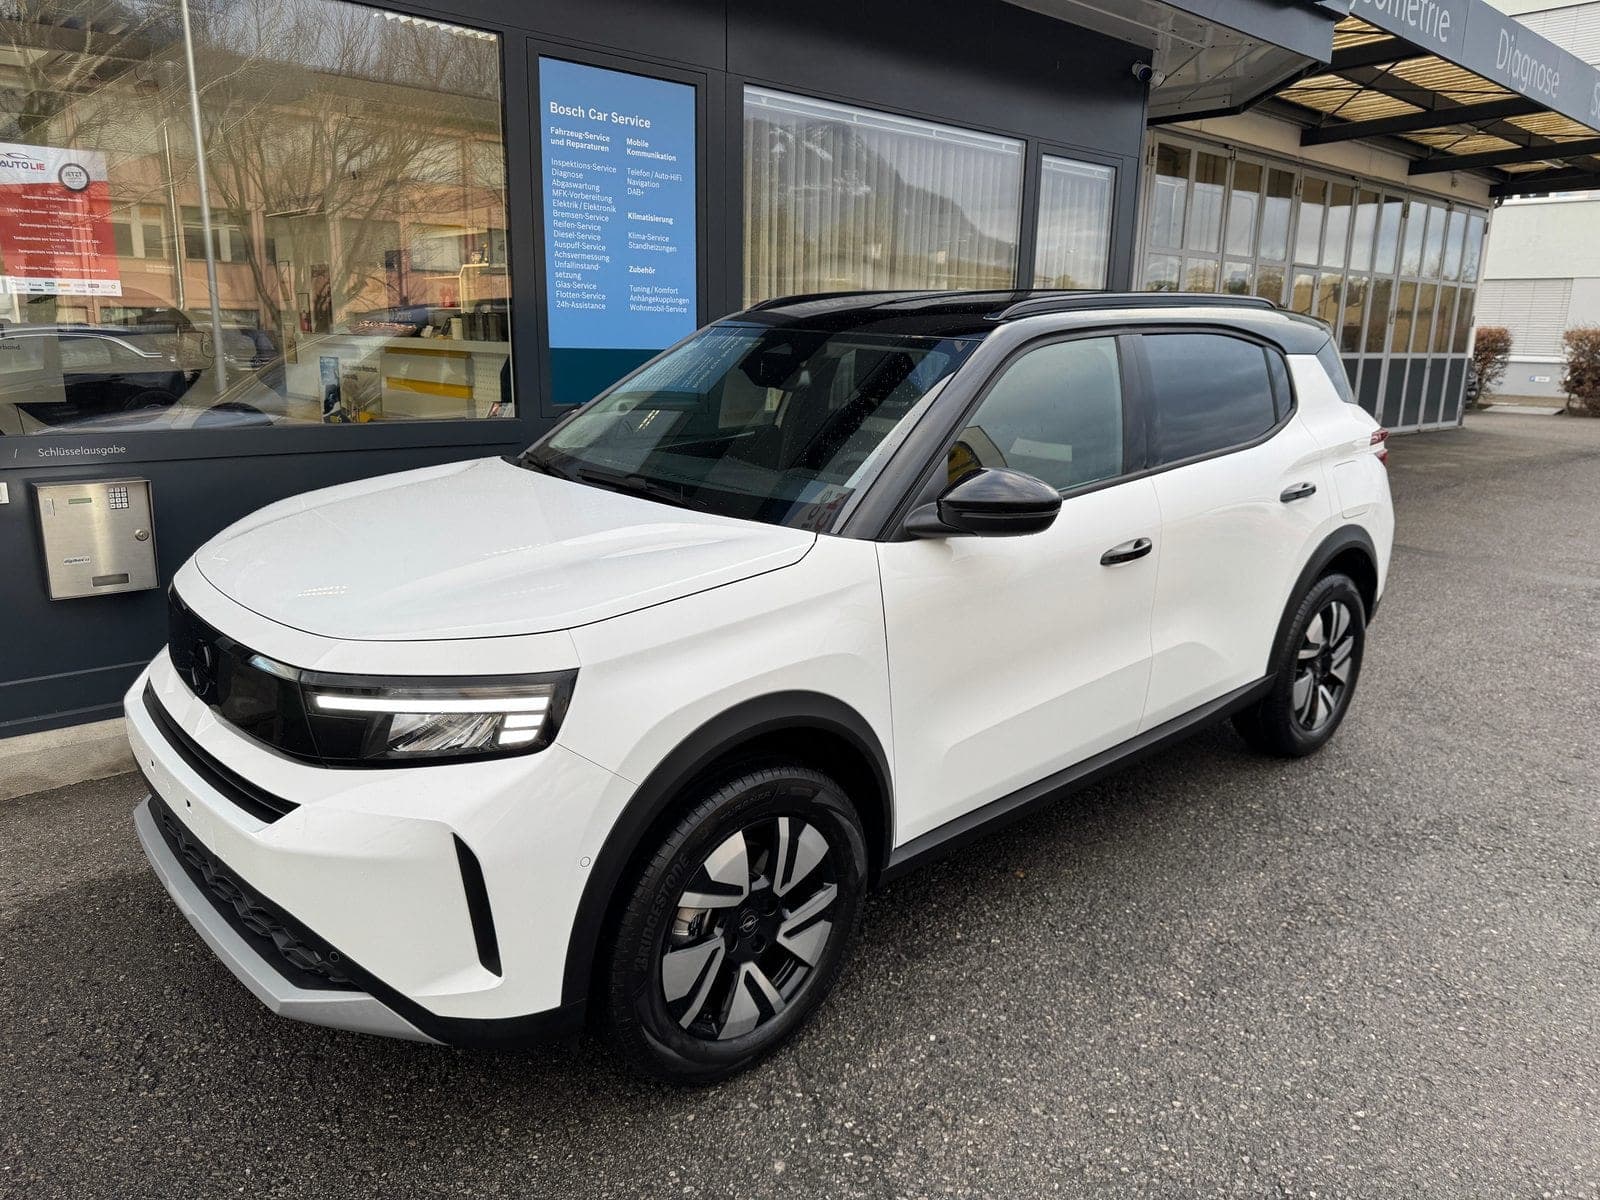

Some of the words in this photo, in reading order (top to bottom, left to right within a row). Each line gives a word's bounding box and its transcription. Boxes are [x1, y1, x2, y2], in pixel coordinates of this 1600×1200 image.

[1496, 28, 1560, 98] Diagnose
[549, 101, 585, 118] Bosch
[588, 108, 609, 122] Car
[611, 112, 651, 128] Service
[550, 126, 610, 143] Fahrzeug-Service
[550, 138, 565, 146] und
[566, 139, 609, 152] Reparaturen
[626, 137, 649, 148] Mobile
[626, 148, 677, 161] Kommunikation
[551, 158, 617, 173] Inspektions-Service
[551, 169, 584, 180] Diagnose
[627, 167, 650, 177] Telefon
[551, 179, 600, 192] Abgaswartung
[627, 178, 660, 188] Navigation
[552, 189, 613, 203] MFK-Vorbereitung
[552, 200, 578, 209] Elektrik
[583, 203, 616, 212] Elektronik
[552, 210, 609, 222] Bremsen-Service
[627, 212, 674, 225] Klimatisierung
[553, 220, 601, 231] Reifen-Service
[553, 230, 601, 241] Diesel-Service
[627, 232, 669, 242] Klima-Service
[554, 240, 606, 251] Auspuff-Service
[628, 242, 677, 253] Standheizungen
[554, 251, 610, 262] Achsvermessung
[554, 261, 601, 271] Unfallinstand-
[628, 265, 656, 274] Zubehör
[554, 271, 582, 280] setzung
[555, 281, 597, 290] Glas-Service
[630, 285, 651, 294] Tuning
[556, 291, 606, 300] Flotten-Service
[629, 294, 690, 305] Anhängekupplungen
[556, 300, 606, 310] 24h-Assistance
[629, 304, 687, 314] Wohnmobil-Service
[38, 445, 126, 457] Schlüsselausgabe
